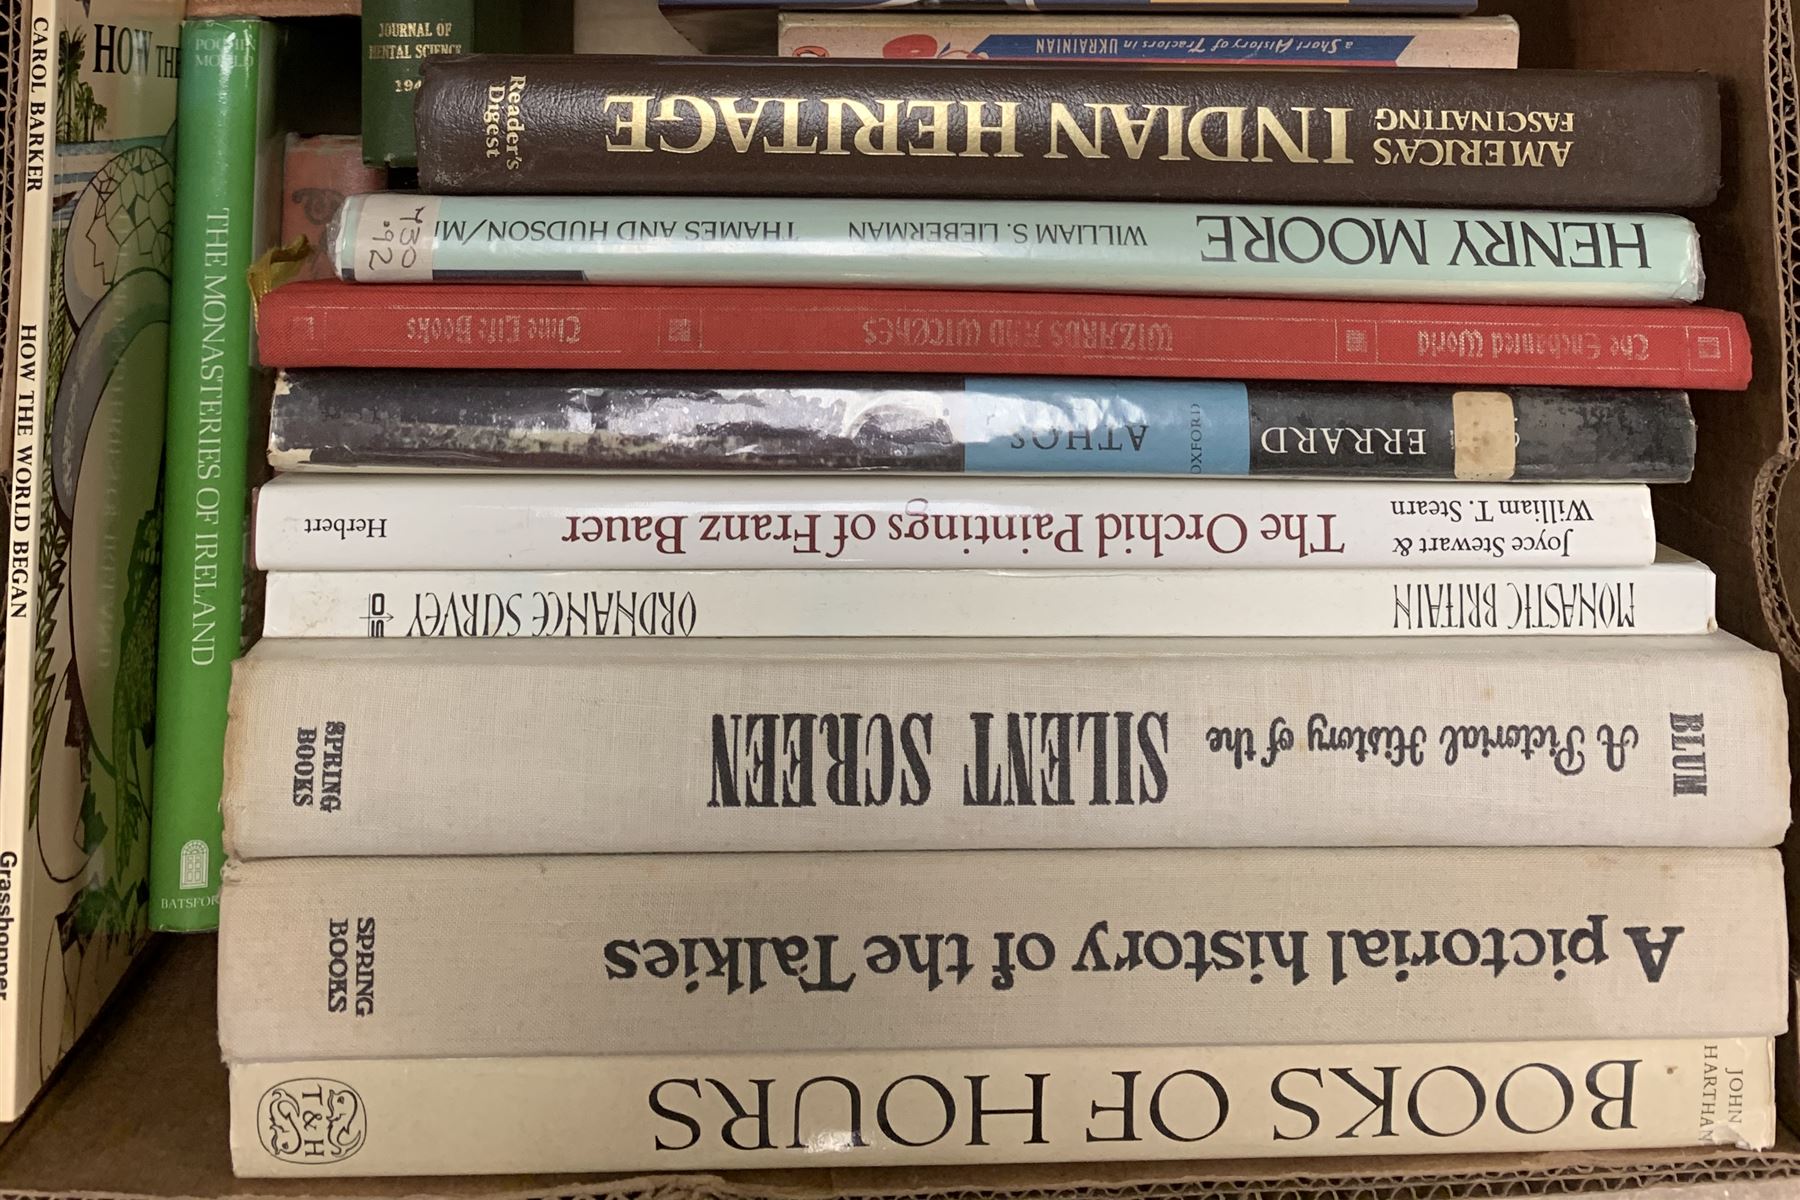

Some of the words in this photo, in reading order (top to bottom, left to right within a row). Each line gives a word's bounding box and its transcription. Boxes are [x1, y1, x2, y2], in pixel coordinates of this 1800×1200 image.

[93, 23, 154, 77] HOW
[368, 44, 412, 59] MENTAL
[378, 22, 432, 38] JOURNAL
[436, 22, 452, 37] OF
[1035, 38, 1118, 55] UKRAINIAN
[1142, 38, 1206, 54] Tractors
[1210, 38, 1229, 52] of
[1296, 38, 1341, 53] Short
[32, 17, 49, 94] CAROL
[486, 86, 505, 159] Digest
[605, 95, 1024, 157] HERITAGE
[1044, 101, 1354, 165] INDIAN
[1375, 108, 1575, 133] FASCINATING
[27, 101, 47, 193] BARKER
[205, 207, 229, 267] THE
[617, 220, 677, 242] AND
[685, 220, 800, 243] THAMES
[848, 221, 999, 245] LIEBERMAN
[1006, 222, 1029, 246] S.
[1036, 224, 1148, 247] WILLIAM
[1196, 215, 1430, 266] MOORE
[1448, 220, 1652, 269] HENRY
[20, 324, 37, 382] HOW
[406, 314, 472, 344] Books
[1417, 329, 1483, 359] World
[1491, 332, 1600, 361] Enchanted
[1609, 333, 1650, 361] The
[197, 276, 227, 480] MONASTERIES
[17, 391, 34, 436] THE
[1189, 402, 1203, 475] OXFORD
[14, 445, 34, 532] WORLD
[195, 487, 221, 527] OF
[1390, 500, 1461, 521] Stearn
[1471, 500, 1494, 521] T.
[1500, 499, 1594, 521] William
[304, 517, 388, 539] Herbert
[561, 515, 687, 554] Bauer
[699, 513, 821, 554] Franz
[826, 513, 876, 557] of
[889, 498, 1082, 554] Paintings
[1099, 513, 1248, 557] Orchid
[1260, 512, 1345, 557] The
[1392, 537, 1412, 555] &
[1418, 536, 1504, 557] Stewart
[1511, 529, 1574, 557] Joyce
[10, 540, 30, 618] BEGAN
[191, 534, 219, 666] IRELAND
[407, 592, 522, 637] SURVEY
[533, 591, 697, 637] ORDNANCE
[1393, 582, 1497, 630] BRITAIN
[1507, 582, 1635, 629] MONASTIC
[707, 712, 933, 808] SCREEN
[963, 711, 1169, 807] SILENT
[1206, 725, 1256, 770] the
[1261, 717, 1295, 768] of
[1307, 712, 1427, 768] History
[1439, 723, 1586, 776] Pictorial
[1595, 723, 1639, 772] A
[1669, 711, 1708, 797] BLUM
[293, 726, 317, 809] BOOKS
[320, 721, 346, 814] SPRING
[327, 918, 349, 1014] BOOKS
[355, 916, 376, 1018] SPRING
[603, 934, 856, 995] Talkies
[864, 932, 971, 992] the
[991, 931, 1056, 991] of
[1074, 921, 1309, 986] history
[1329, 914, 1608, 985] pictorial
[1622, 926, 1685, 983] A
[648, 1074, 1051, 1151] HOURS
[1086, 1069, 1230, 1143] OF
[1273, 1059, 1642, 1141] BOOKS
[1698, 1045, 1718, 1143] HARTHAN
[1725, 1066, 1744, 1123] JOHN
